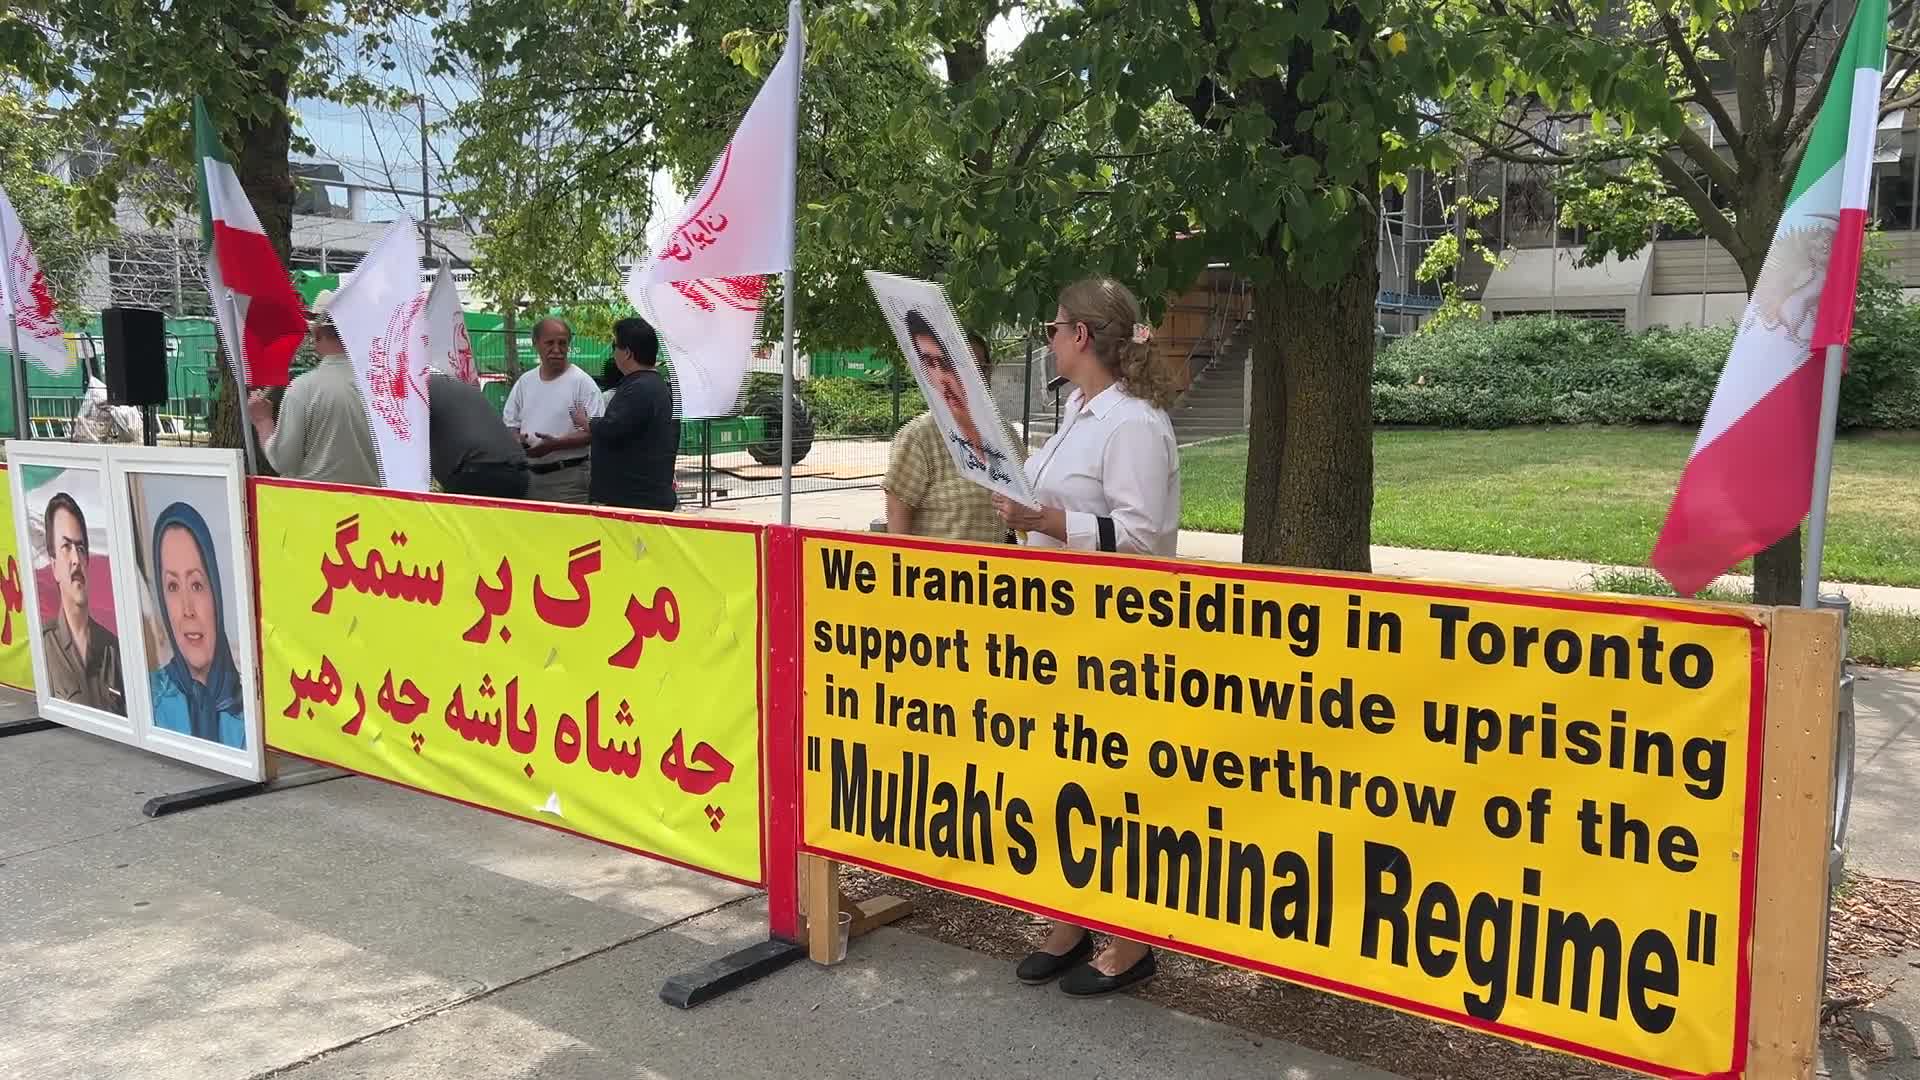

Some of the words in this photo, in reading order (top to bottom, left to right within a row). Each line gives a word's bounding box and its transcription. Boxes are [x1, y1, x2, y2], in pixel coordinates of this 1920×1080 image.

[311, 513, 444, 615] ستمگر
[462, 556, 513, 644] بر
[820, 547, 876, 594] We
[892, 552, 1075, 616] iranians
[1095, 580, 1321, 657] residing
[1346, 594, 1402, 654] in
[1429, 603, 1714, 690] Toronto
[377, 669, 430, 754] چه
[444, 673, 538, 778] باشه
[554, 691, 642, 779] شاه
[813, 620, 969, 673] support
[985, 633, 1058, 685] the
[1077, 652, 1396, 735] nationwide
[1422, 700, 1727, 801] uprising
[660, 729, 735, 833] چه
[824, 673, 860, 721] in
[875, 682, 956, 738] Iran
[972, 698, 1036, 751] for
[1052, 713, 1129, 770] the
[1148, 739, 1457, 829] overthrow
[1483, 788, 1552, 845] of
[1576, 798, 1699, 873] the
[1055, 781, 1334, 949] Criminal
